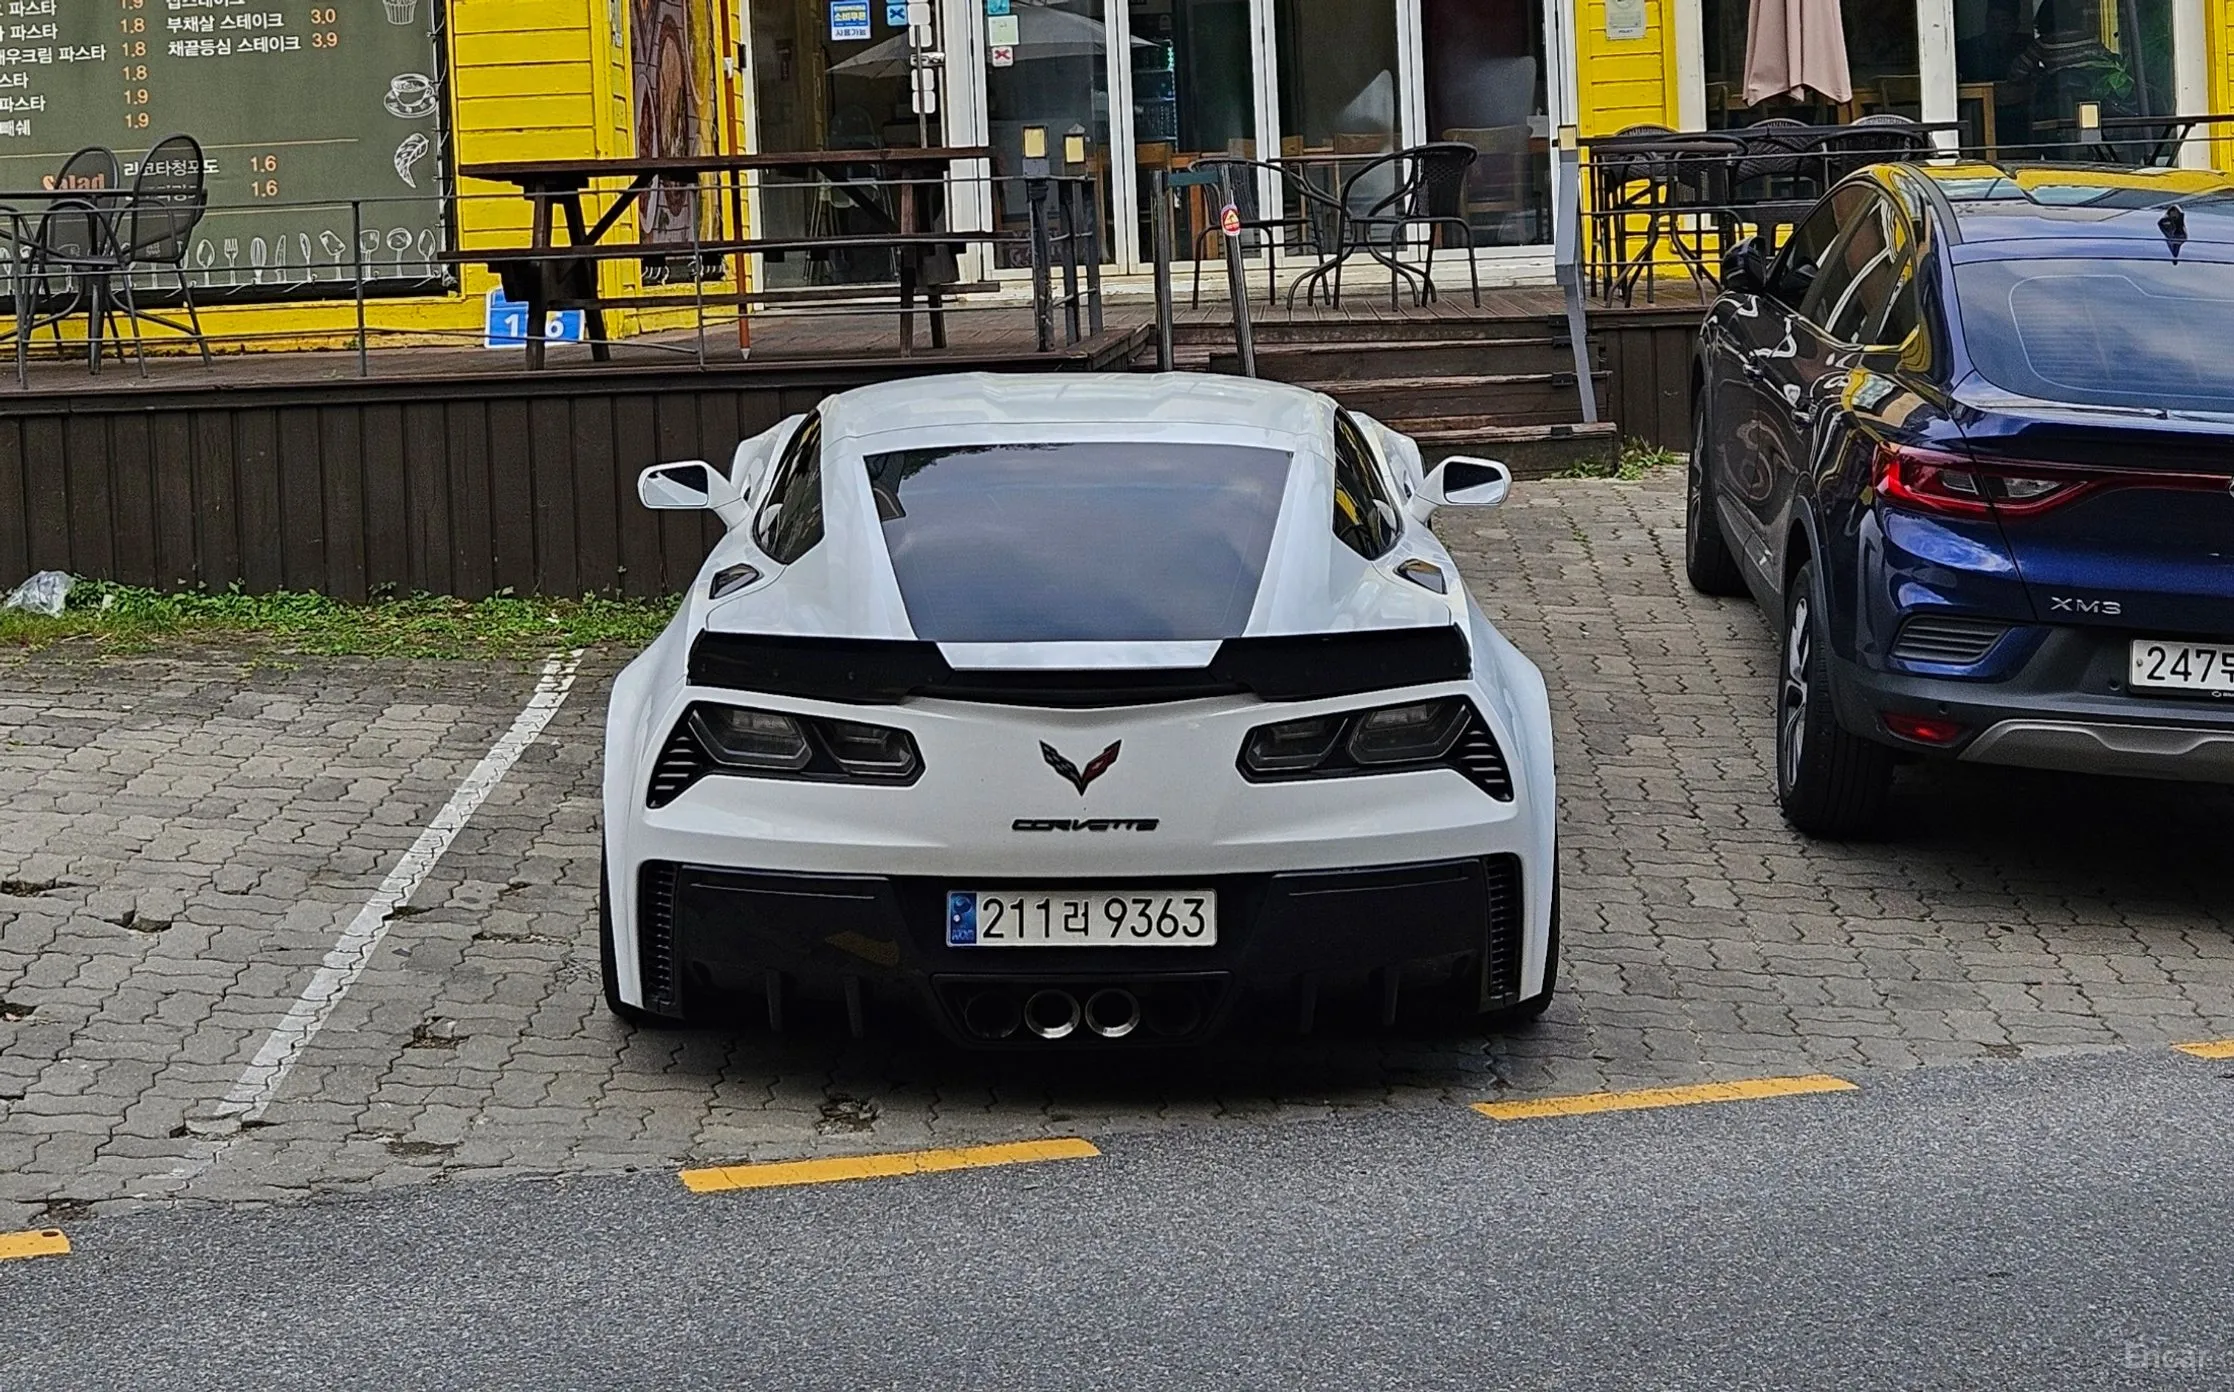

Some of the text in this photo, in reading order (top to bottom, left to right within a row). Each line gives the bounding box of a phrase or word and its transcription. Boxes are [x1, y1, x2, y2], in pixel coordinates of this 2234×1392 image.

[9, 0, 57, 17] 파스타
[10, 23, 58, 41] 파스타
[120, 18, 145, 33] 1.8
[166, 9, 336, 33] 부채살 스테이크 3.0
[59, 44, 107, 62] 파스타
[121, 42, 146, 57] 1.8
[168, 32, 338, 57] 채끝등심 스테이크 3.9
[122, 65, 148, 81] 1.8
[0, 89, 149, 112] 파스타 1.9
[125, 113, 150, 128] 1.9
[251, 155, 277, 173] 1.6
[252, 180, 279, 197] 1.6
[504, 313, 564, 338] 16
[2050, 596, 2121, 615] XM3
[1011, 818, 1160, 831] CORVETTE
[982, 898, 1205, 938] 211러 9363
